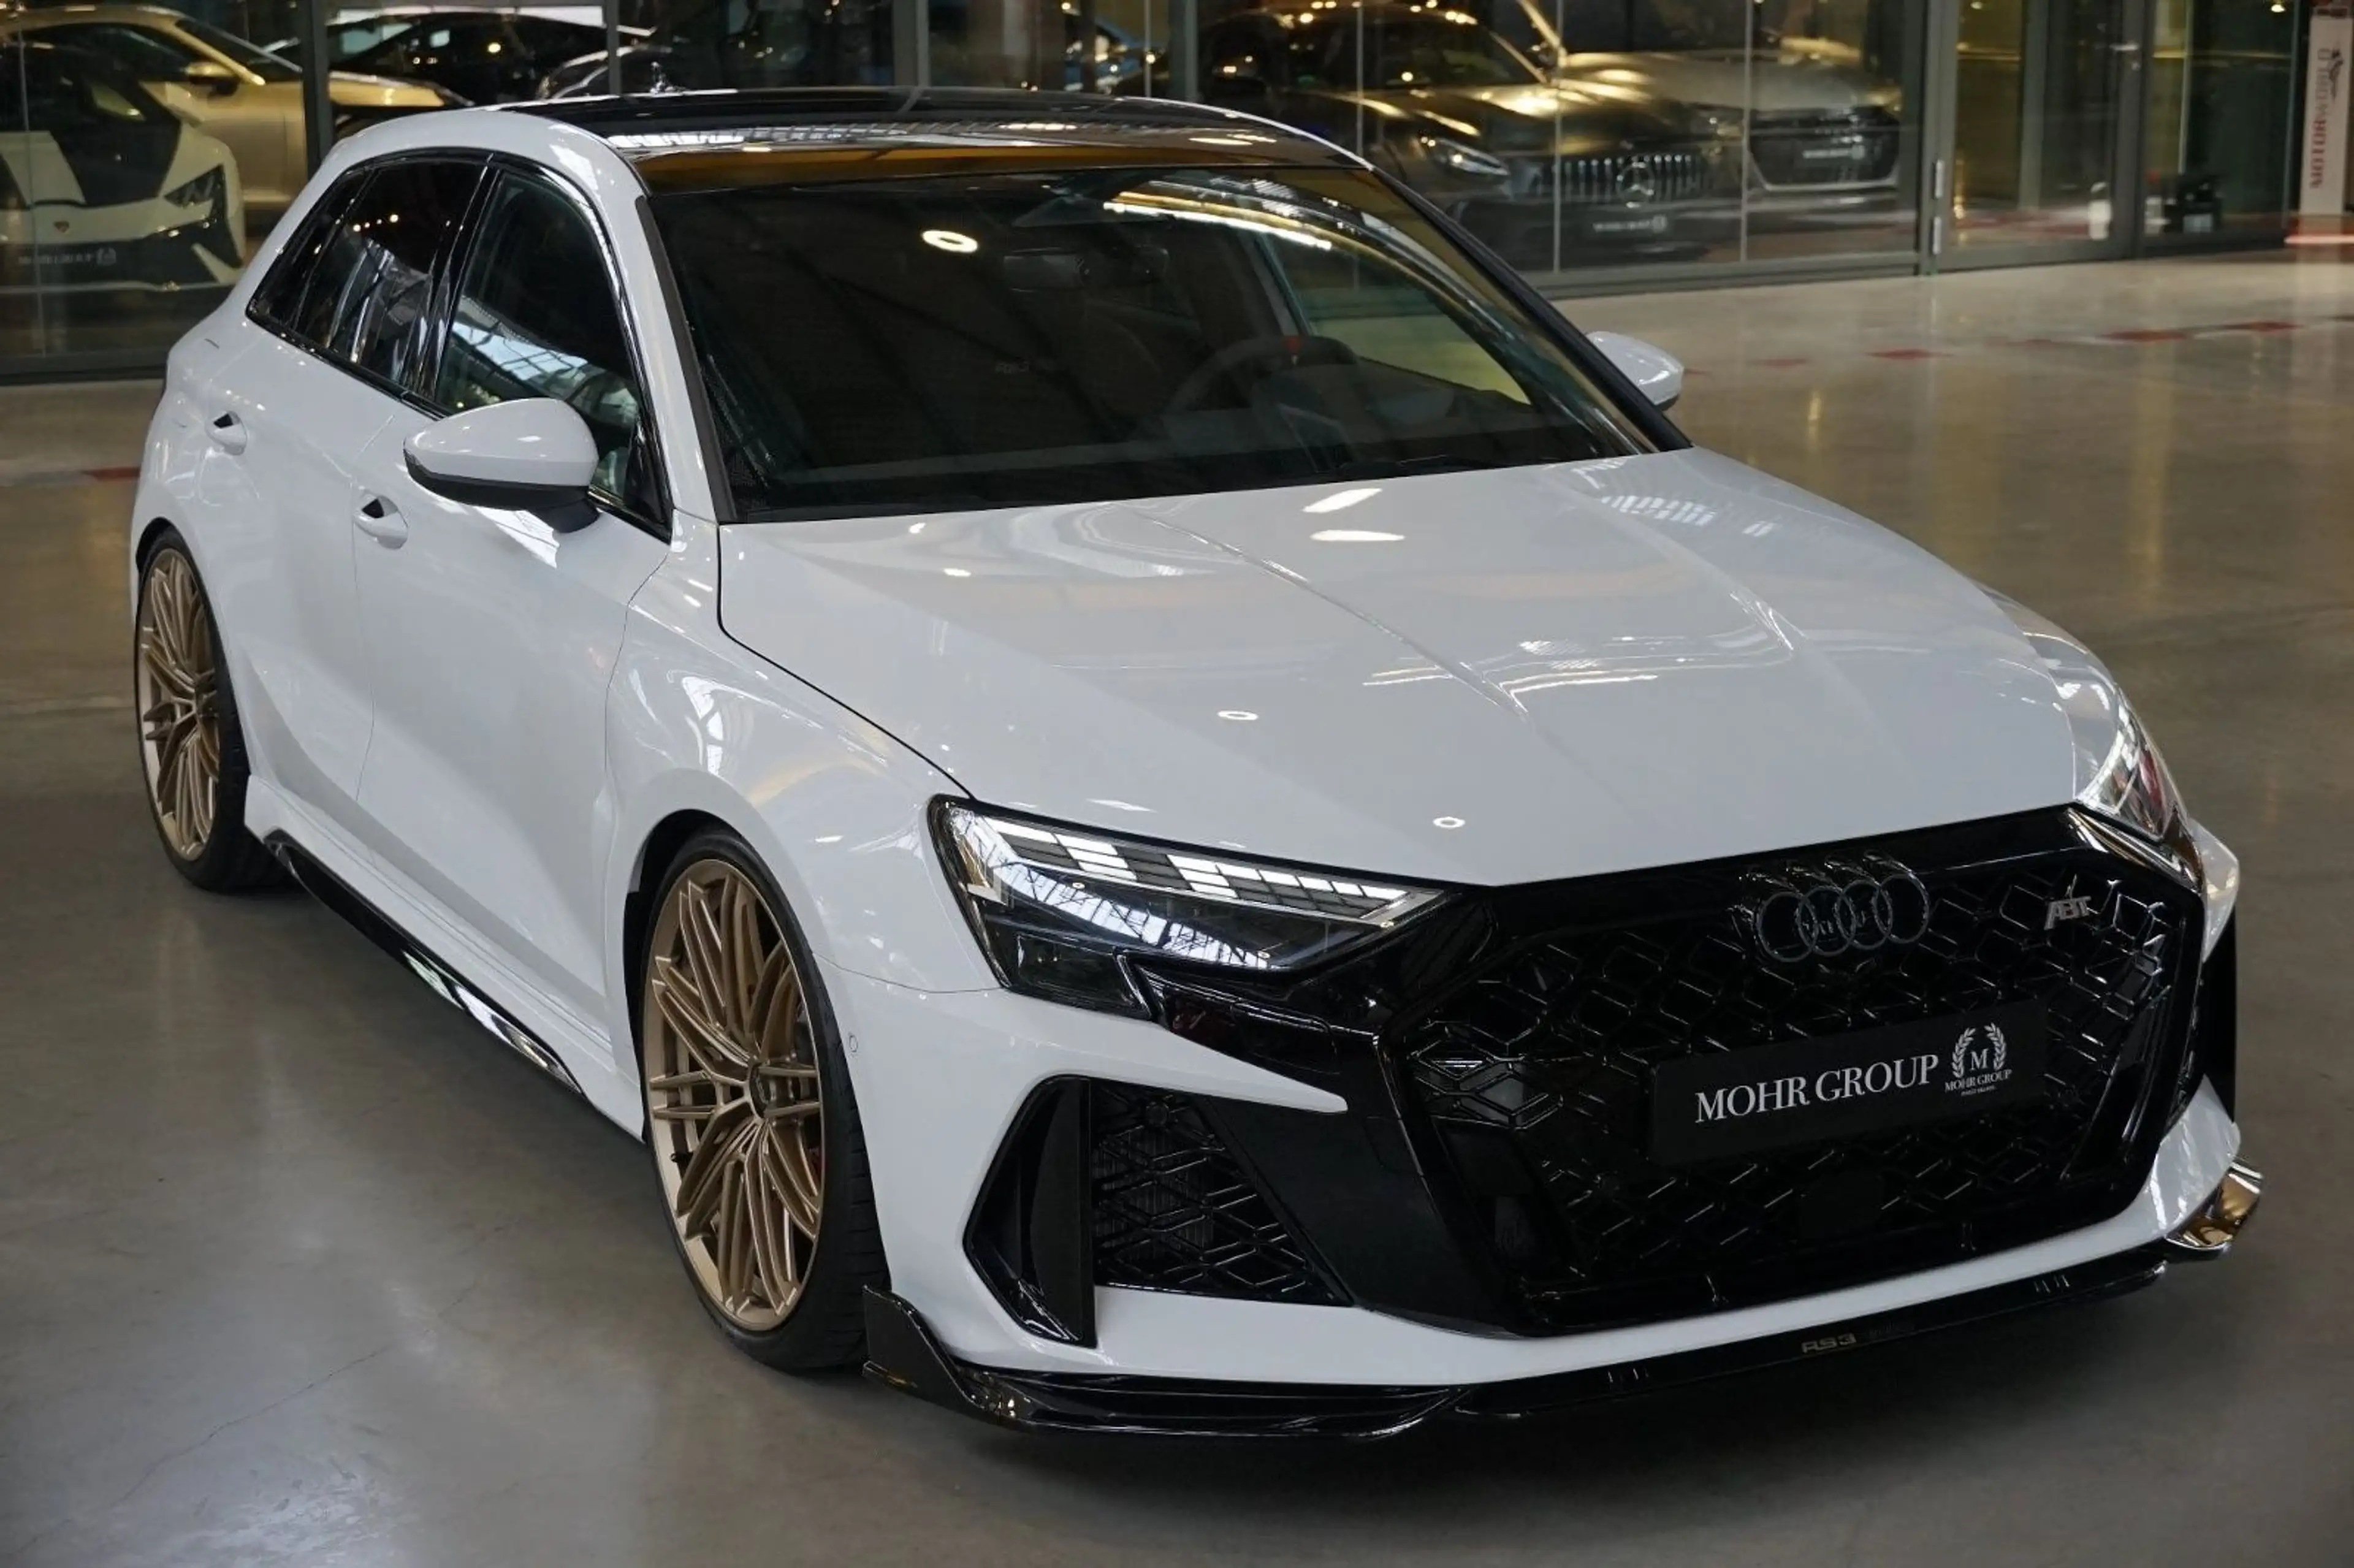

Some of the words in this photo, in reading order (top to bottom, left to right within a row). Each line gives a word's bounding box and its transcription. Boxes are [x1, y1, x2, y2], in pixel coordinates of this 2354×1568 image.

[2044, 896, 2092, 930] ABT
[1970, 1048, 1989, 1071] M
[1696, 1076, 1810, 1123] MOHR
[1816, 1054, 1938, 1102] GROUP
[1945, 1077, 1976, 1094] MOHR
[1977, 1069, 2013, 1085] GROUP
[1801, 1333, 1857, 1353] RS3
